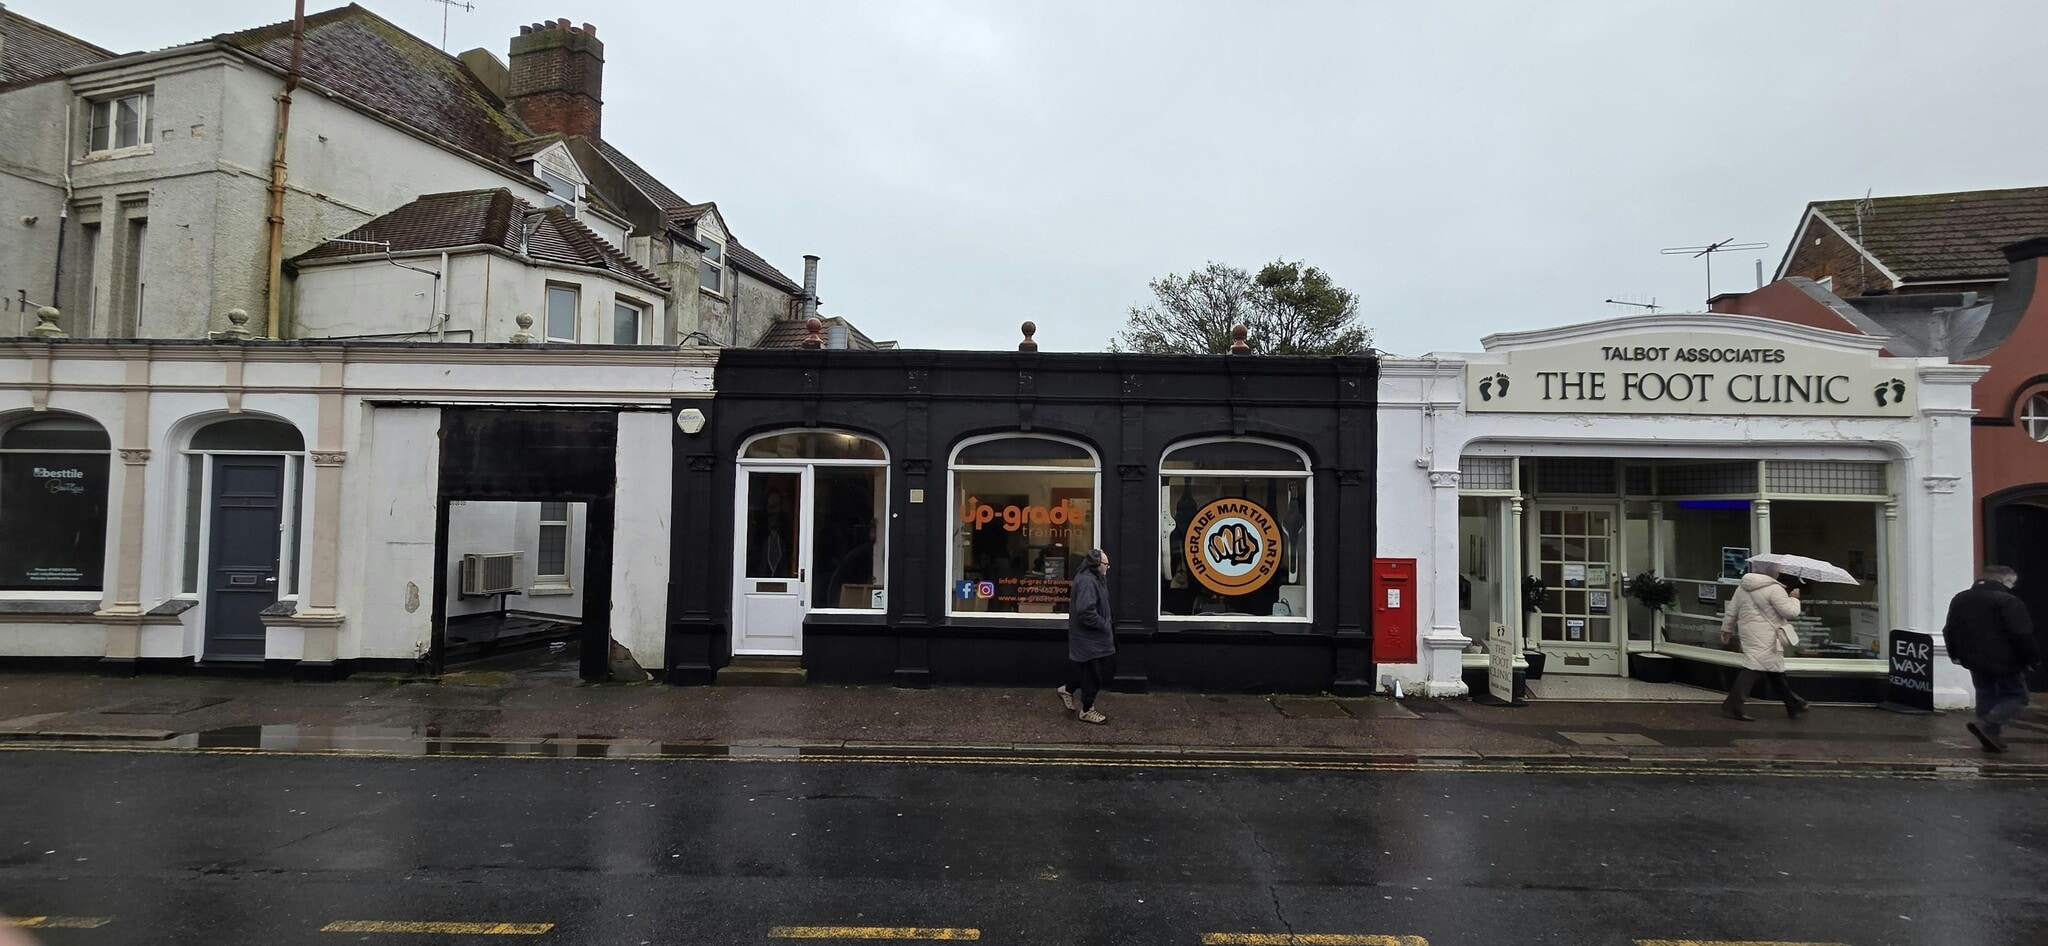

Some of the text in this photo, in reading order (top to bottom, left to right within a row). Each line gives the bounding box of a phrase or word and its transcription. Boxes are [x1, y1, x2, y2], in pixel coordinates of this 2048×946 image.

[1601, 346, 1786, 364] TALBOT ASSOCIATES
[1536, 371, 1850, 404] THE FOOT CLINIC
[43, 468, 84, 479] besttile
[960, 496, 1086, 532] up-grade
[1022, 525, 1083, 540] training
[1190, 503, 1276, 575] UP-GRADE MARTIAL ARTS
[1495, 643, 1507, 656] THE
[1896, 639, 1930, 661] EAR
[1492, 654, 1510, 669] FOOT
[1892, 656, 1926, 676] WAX
[1489, 666, 1512, 683] CLINIC
[1889, 674, 1933, 692] REMOVAL
